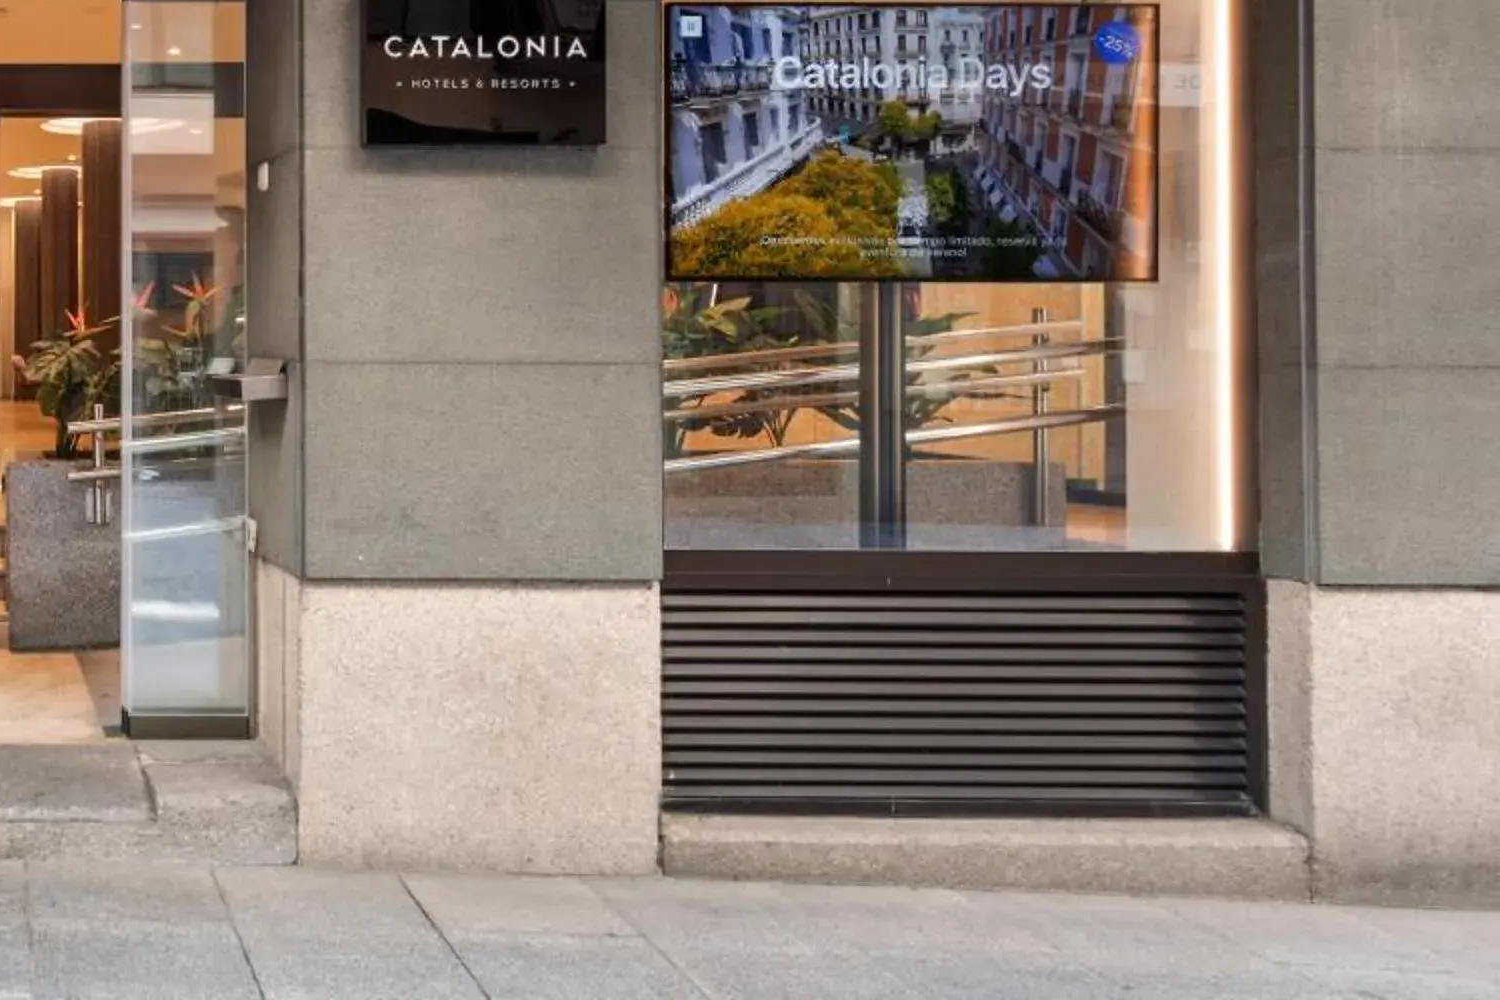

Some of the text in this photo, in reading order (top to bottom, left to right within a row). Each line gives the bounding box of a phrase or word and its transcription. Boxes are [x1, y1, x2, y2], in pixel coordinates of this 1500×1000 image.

[384, 35, 587, 58] CATALONIA
[411, 78, 560, 89] HOTELS & RESORTS
[773, 56, 1051, 97] Catalonia Days
